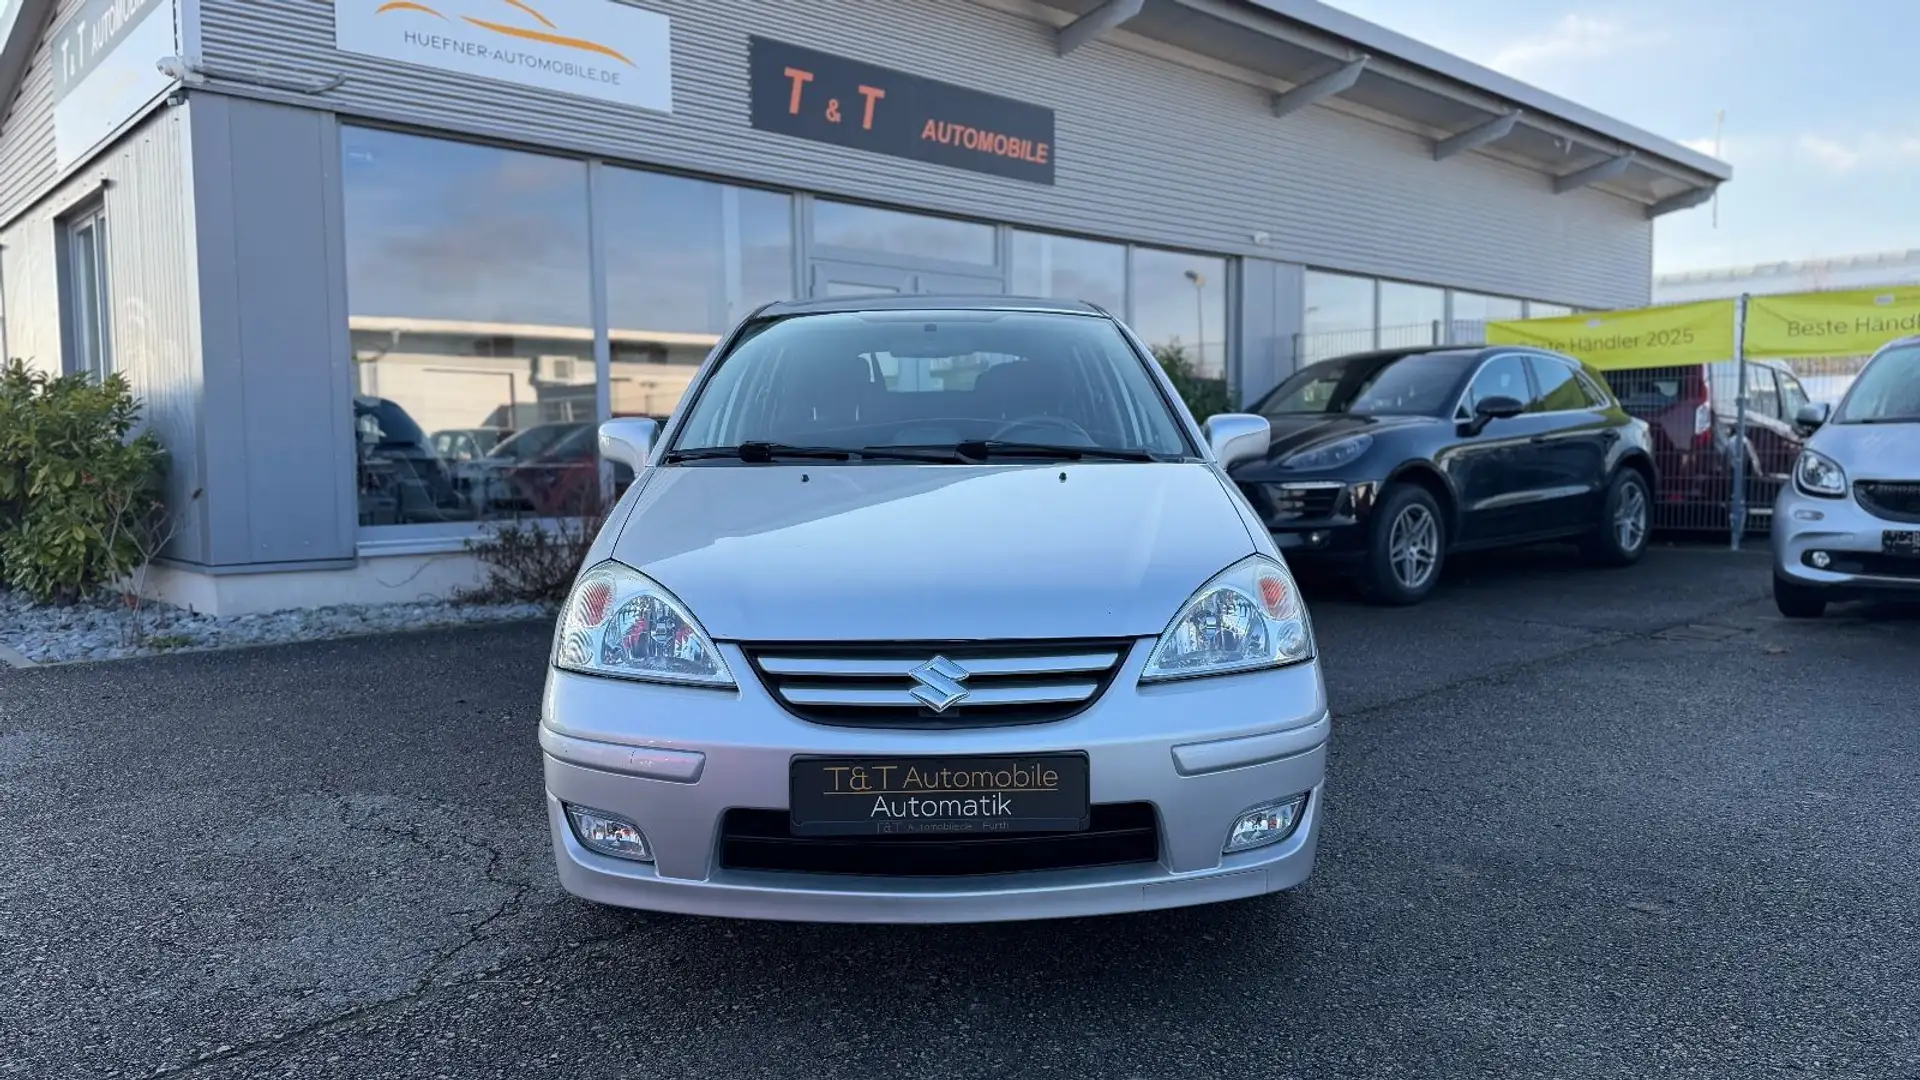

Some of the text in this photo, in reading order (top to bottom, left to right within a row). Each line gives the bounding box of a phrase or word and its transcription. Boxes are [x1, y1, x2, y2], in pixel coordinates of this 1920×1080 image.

[77, 20, 86, 69] T
[404, 30, 621, 86] HUEFNER-AUTOMOBILE.DE
[784, 67, 1050, 164] T & T AUTOMOBILE
[1646, 327, 1695, 348] 2025
[1787, 319, 1848, 337] Beste
[822, 763, 1059, 791] T&T Automobile
[870, 792, 1012, 818] Automatik
